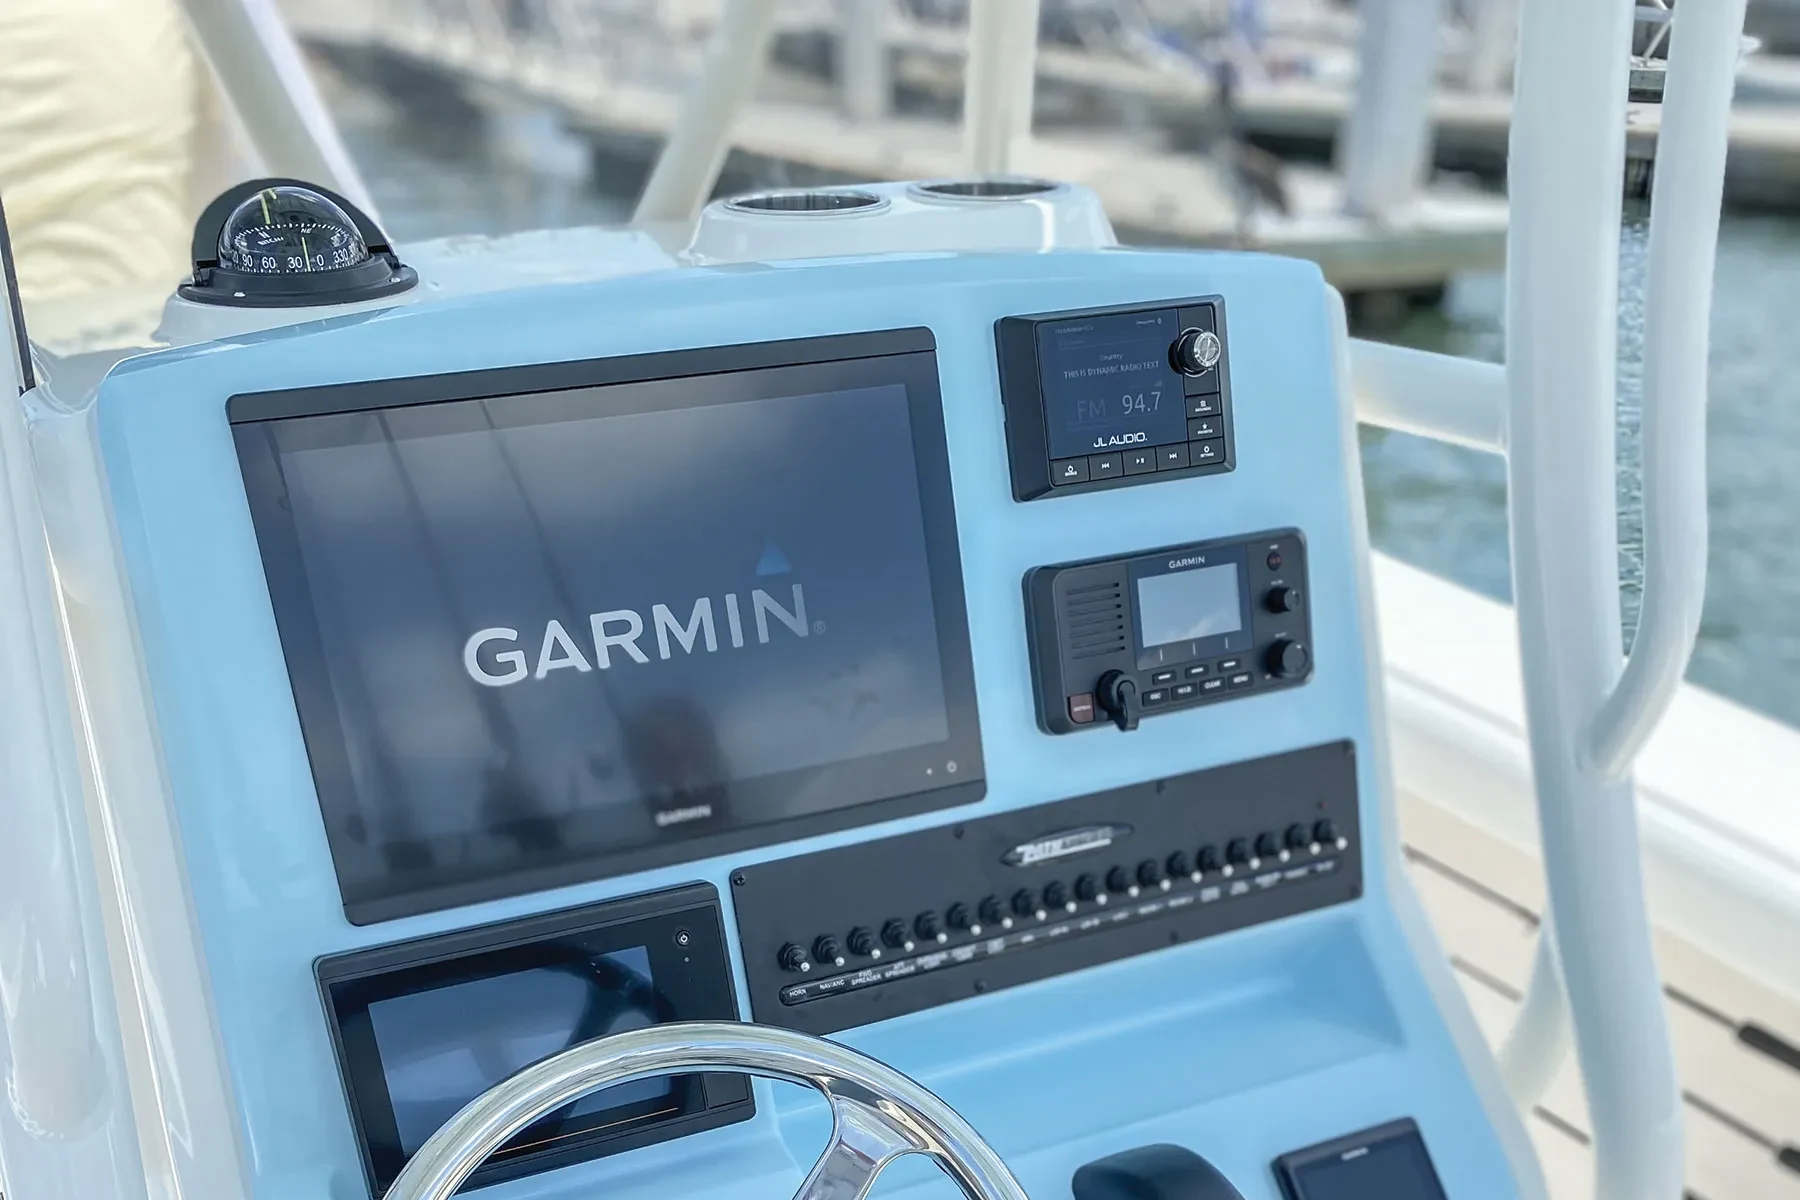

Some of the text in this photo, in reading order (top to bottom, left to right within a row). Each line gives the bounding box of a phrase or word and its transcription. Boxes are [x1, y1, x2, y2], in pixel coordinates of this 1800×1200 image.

[242, 253, 253, 267] 90
[262, 256, 276, 269] 60
[287, 256, 303, 269] 30
[316, 254, 324, 266] 0
[333, 248, 349, 263] 330
[1064, 360, 1159, 379] THIS IS DYNAMIC RADIO TEXT
[1077, 391, 1161, 421] FM 94.7
[1093, 436, 1107, 448] JL
[1168, 556, 1205, 569] GARMIN
[789, 988, 807, 998] HORN
